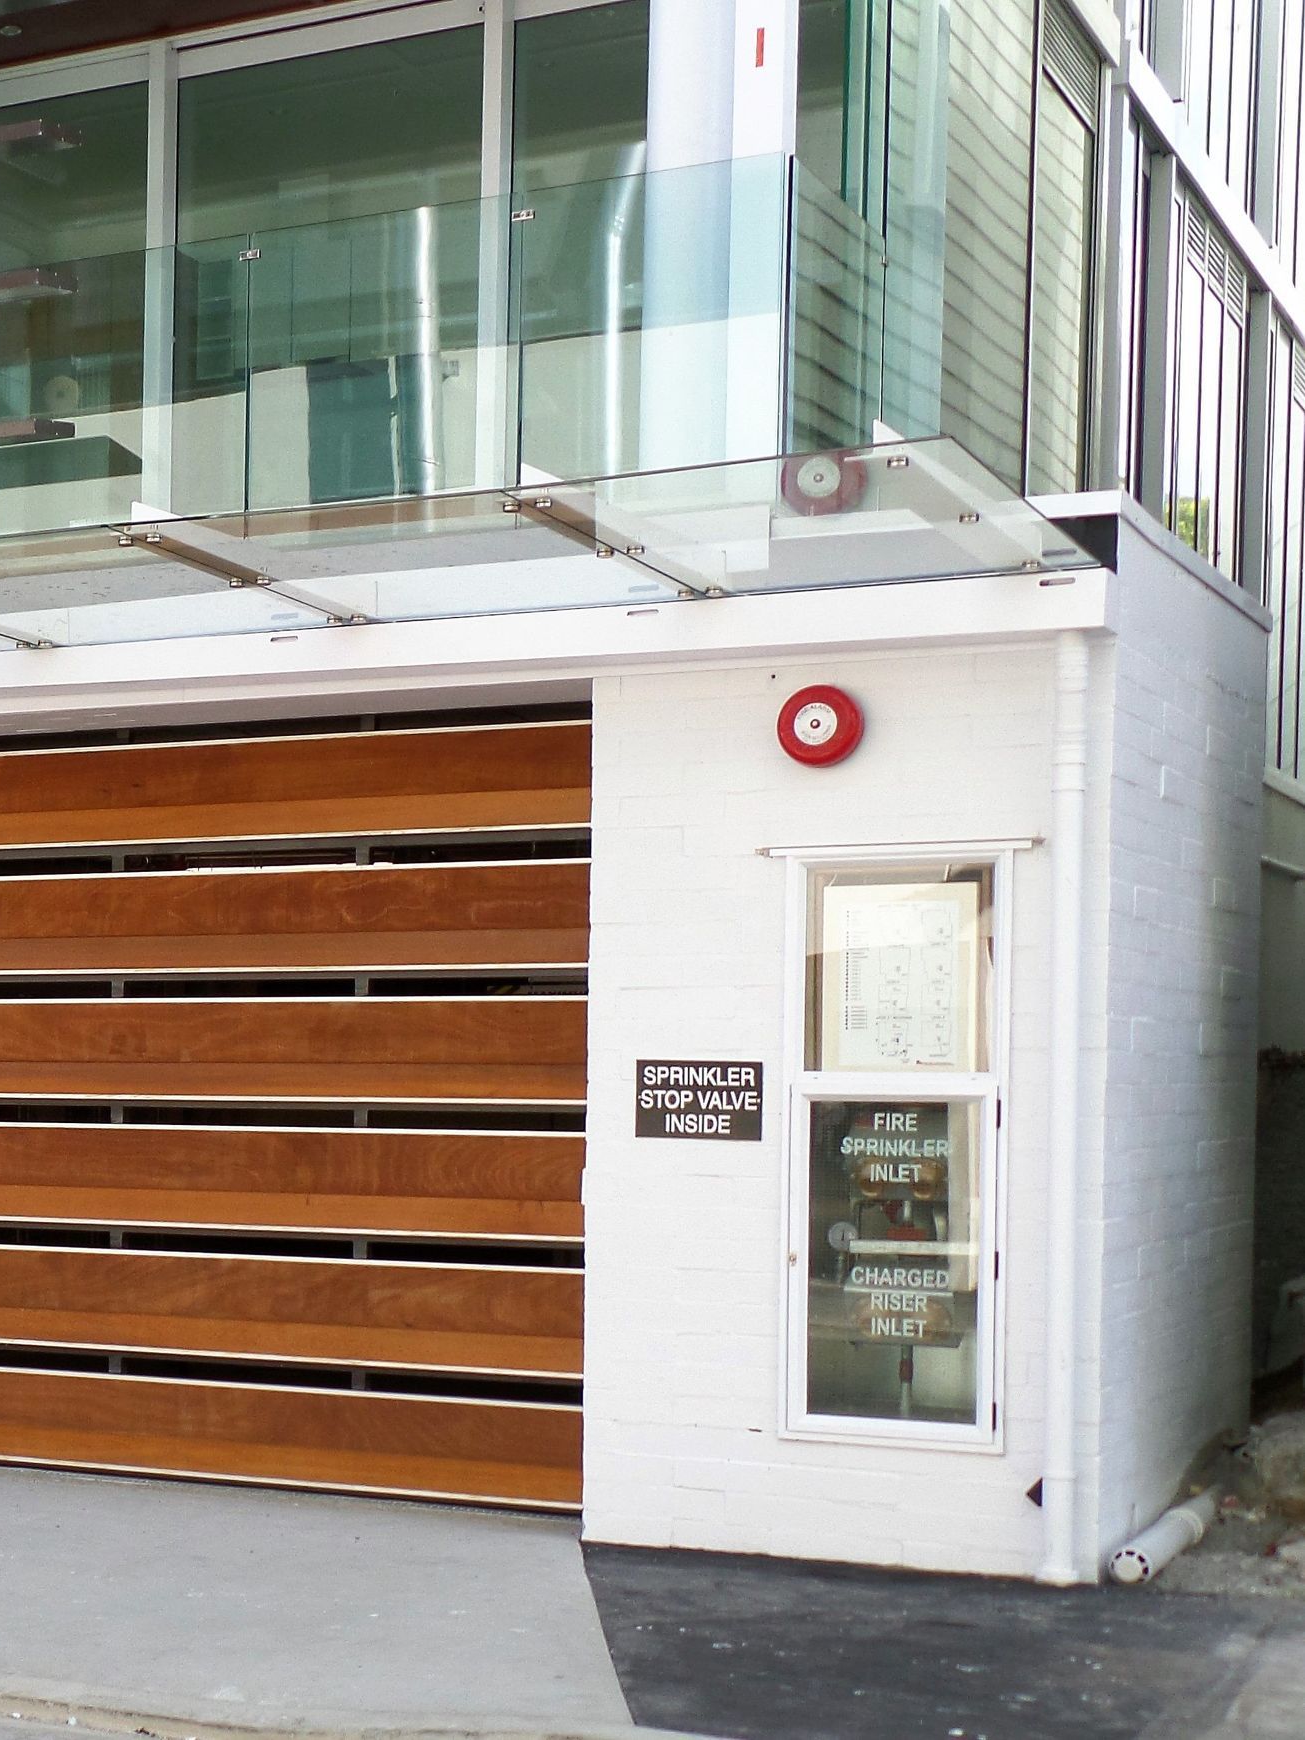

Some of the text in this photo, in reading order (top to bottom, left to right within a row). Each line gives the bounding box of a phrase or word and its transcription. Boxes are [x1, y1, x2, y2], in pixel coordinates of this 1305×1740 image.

[643, 1066, 755, 1086] SPRINKLER
[640, 1089, 758, 1110] STOP VALVE
[665, 1114, 730, 1134] INSIDE
[874, 1112, 917, 1131] FIRE
[841, 1137, 951, 1157] SPRINKLER
[870, 1164, 921, 1183] INLET
[851, 1266, 949, 1288] CHARGED
[871, 1292, 927, 1312] RISER
[871, 1317, 927, 1338] INLET
